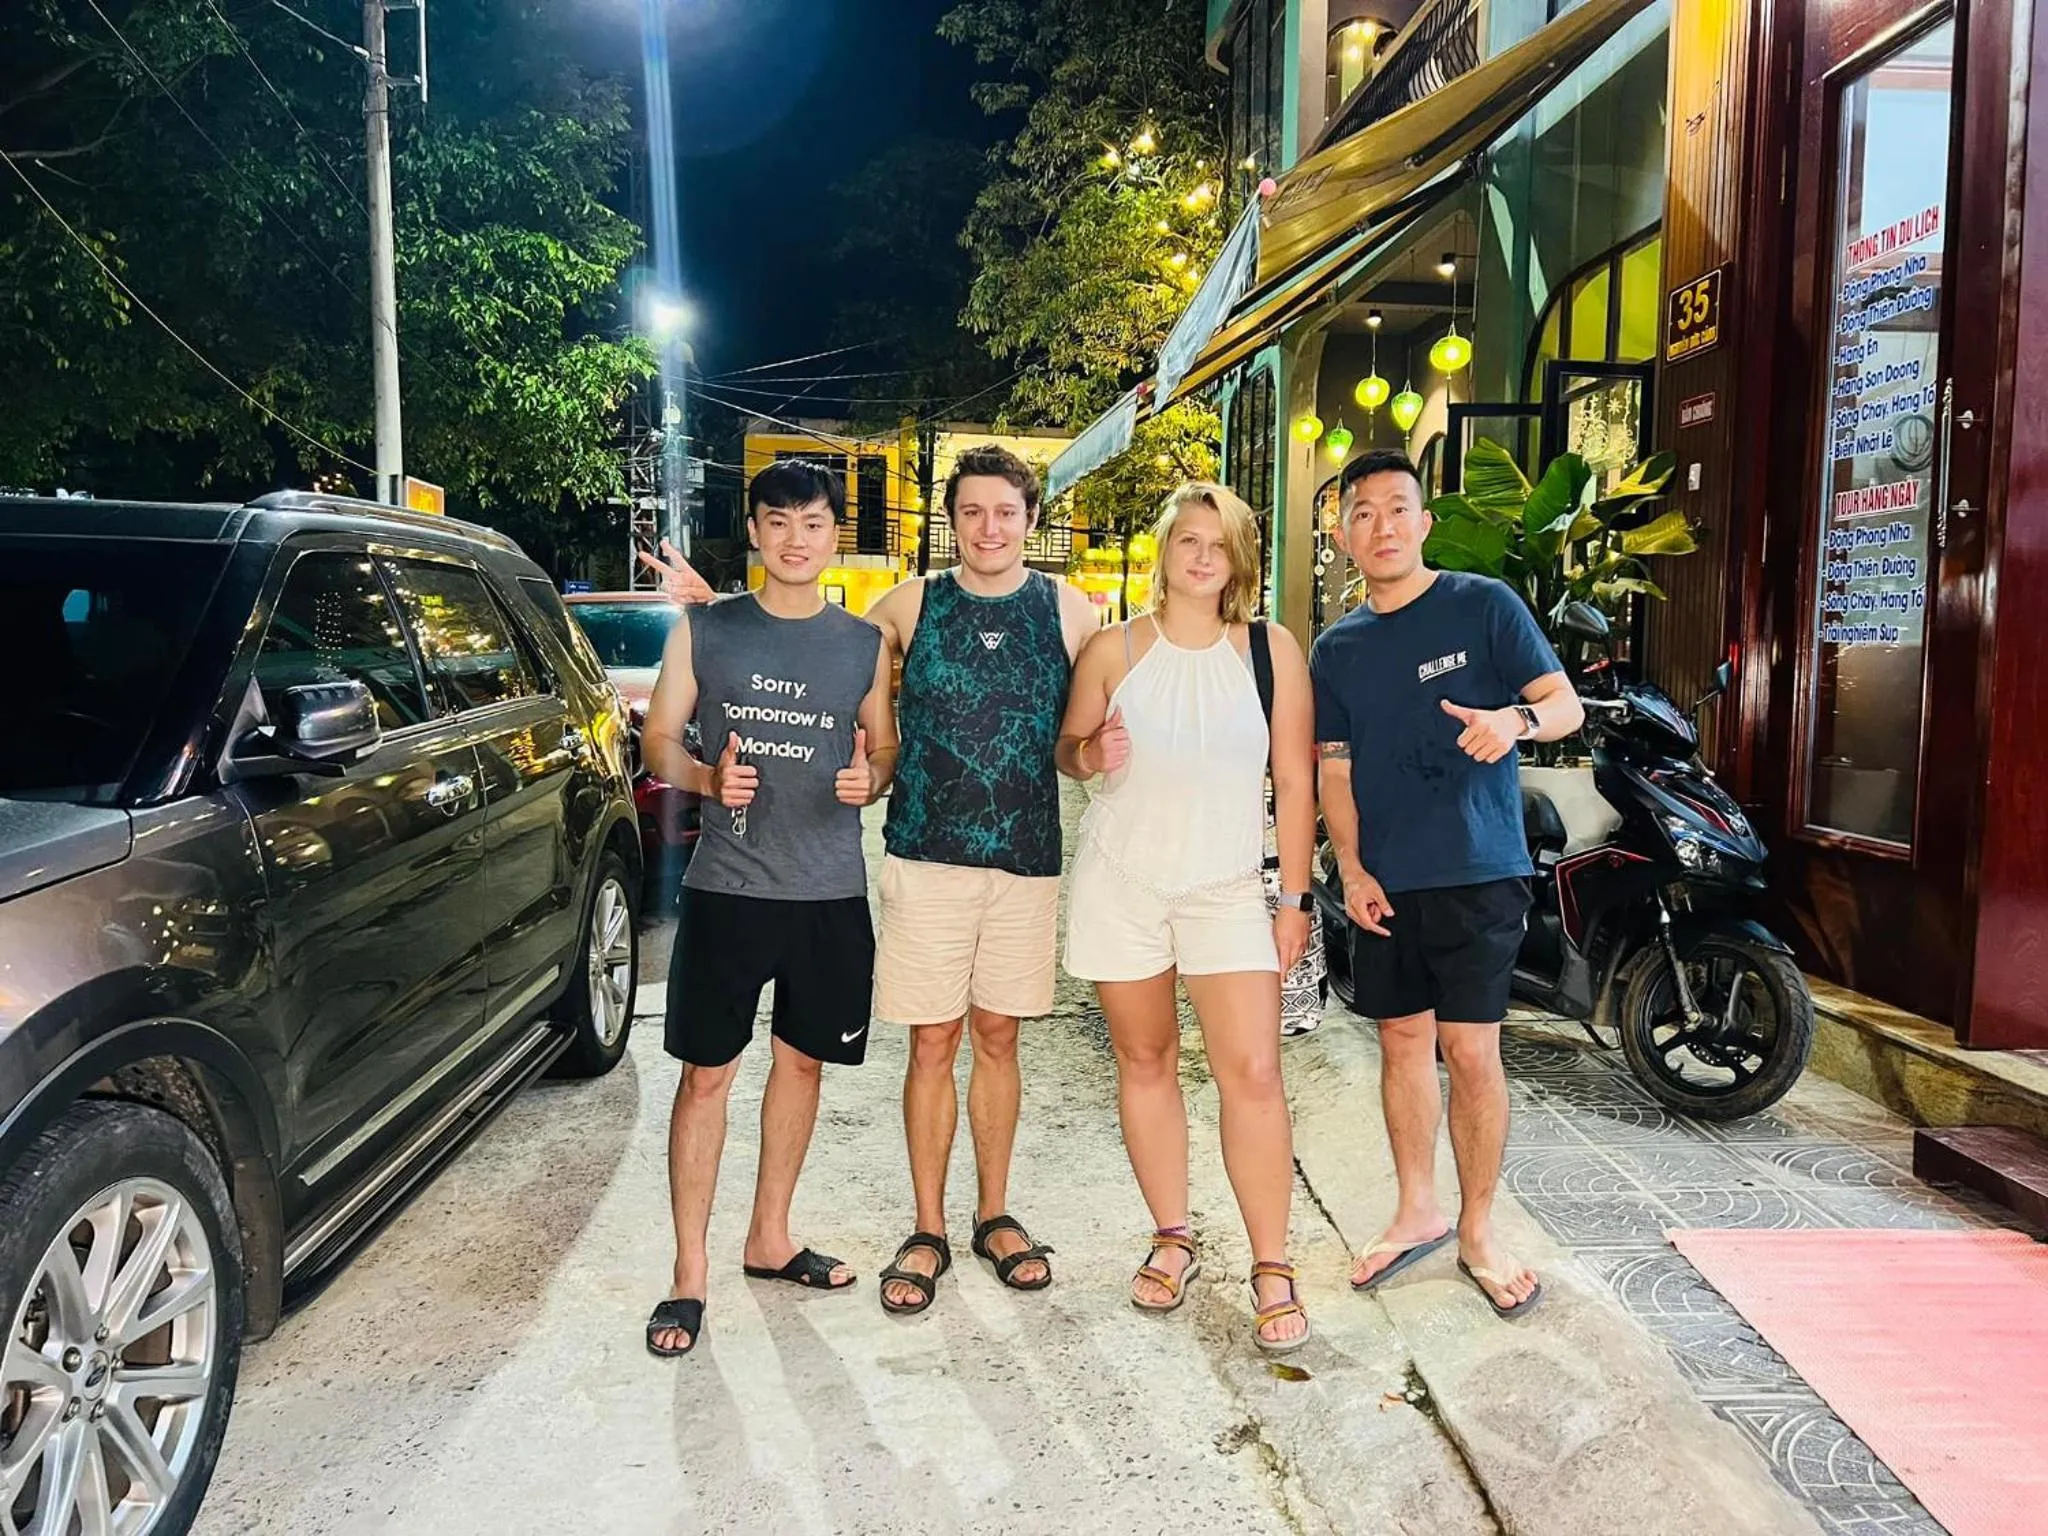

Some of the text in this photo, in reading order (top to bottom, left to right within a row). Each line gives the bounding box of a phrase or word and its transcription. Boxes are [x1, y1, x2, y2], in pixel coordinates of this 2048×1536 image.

[1881, 224, 1897, 252] TIN
[1900, 217, 1913, 246] DU
[1904, 256, 1926, 276] Nha
[1677, 279, 1709, 330] 35
[1839, 345, 1864, 364] Hang
[1837, 377, 1862, 396] Hang
[1891, 393, 1920, 413] Hang
[1836, 490, 1860, 516] TOUR
[1855, 528, 1887, 548] Phong
[1889, 522, 1911, 542] Nha
[1880, 591, 1909, 613] Hang
[722, 702, 835, 730] Tomorrow is
[735, 736, 816, 762] Monday
